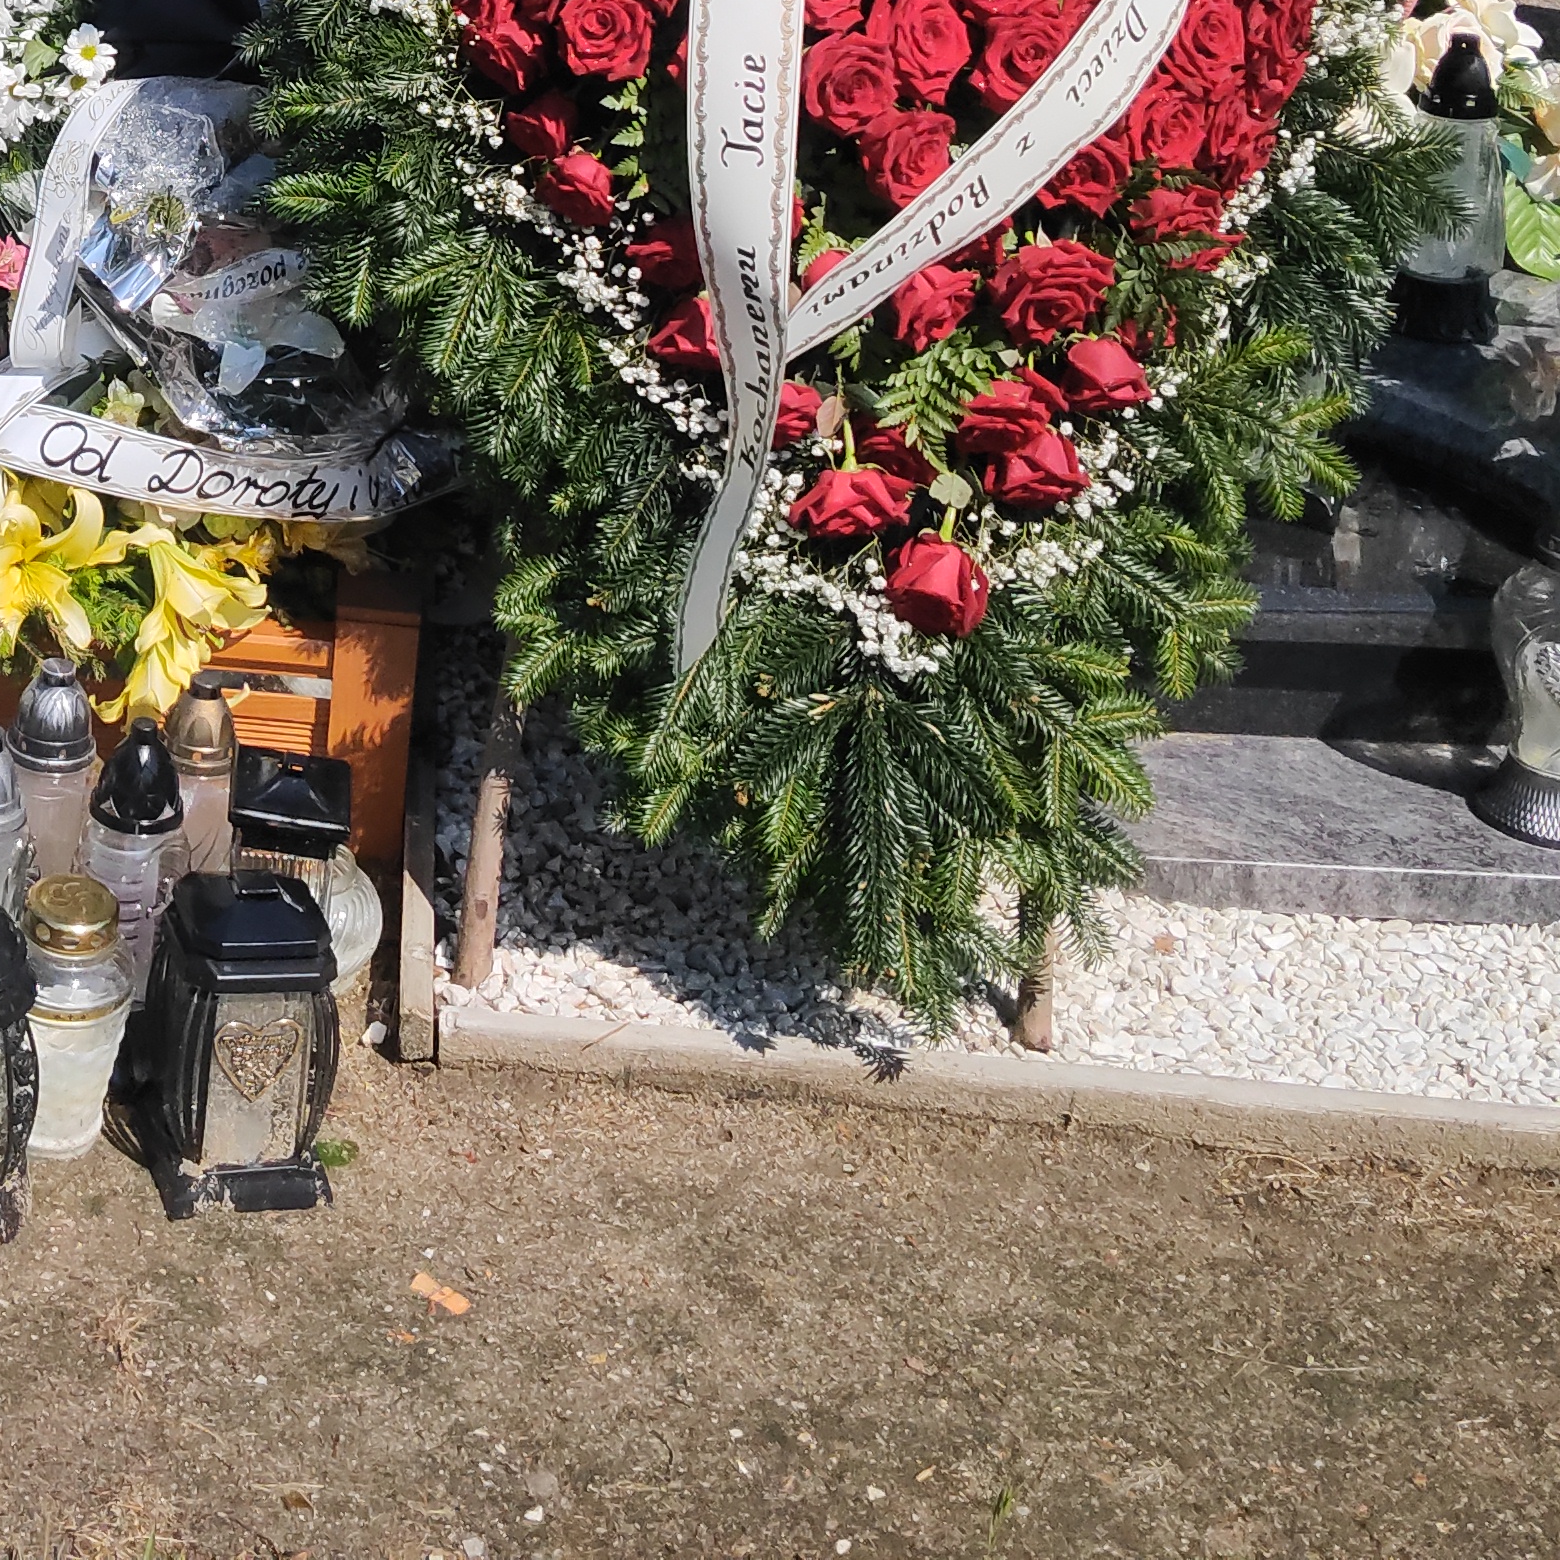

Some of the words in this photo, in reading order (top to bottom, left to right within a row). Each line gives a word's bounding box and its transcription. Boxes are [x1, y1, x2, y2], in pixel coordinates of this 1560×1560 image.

[1015, 131, 1036, 158] z
[806, 175, 991, 317] Rodzinami
[40, 421, 121, 482] Od
[147, 449, 338, 518] Doroty
